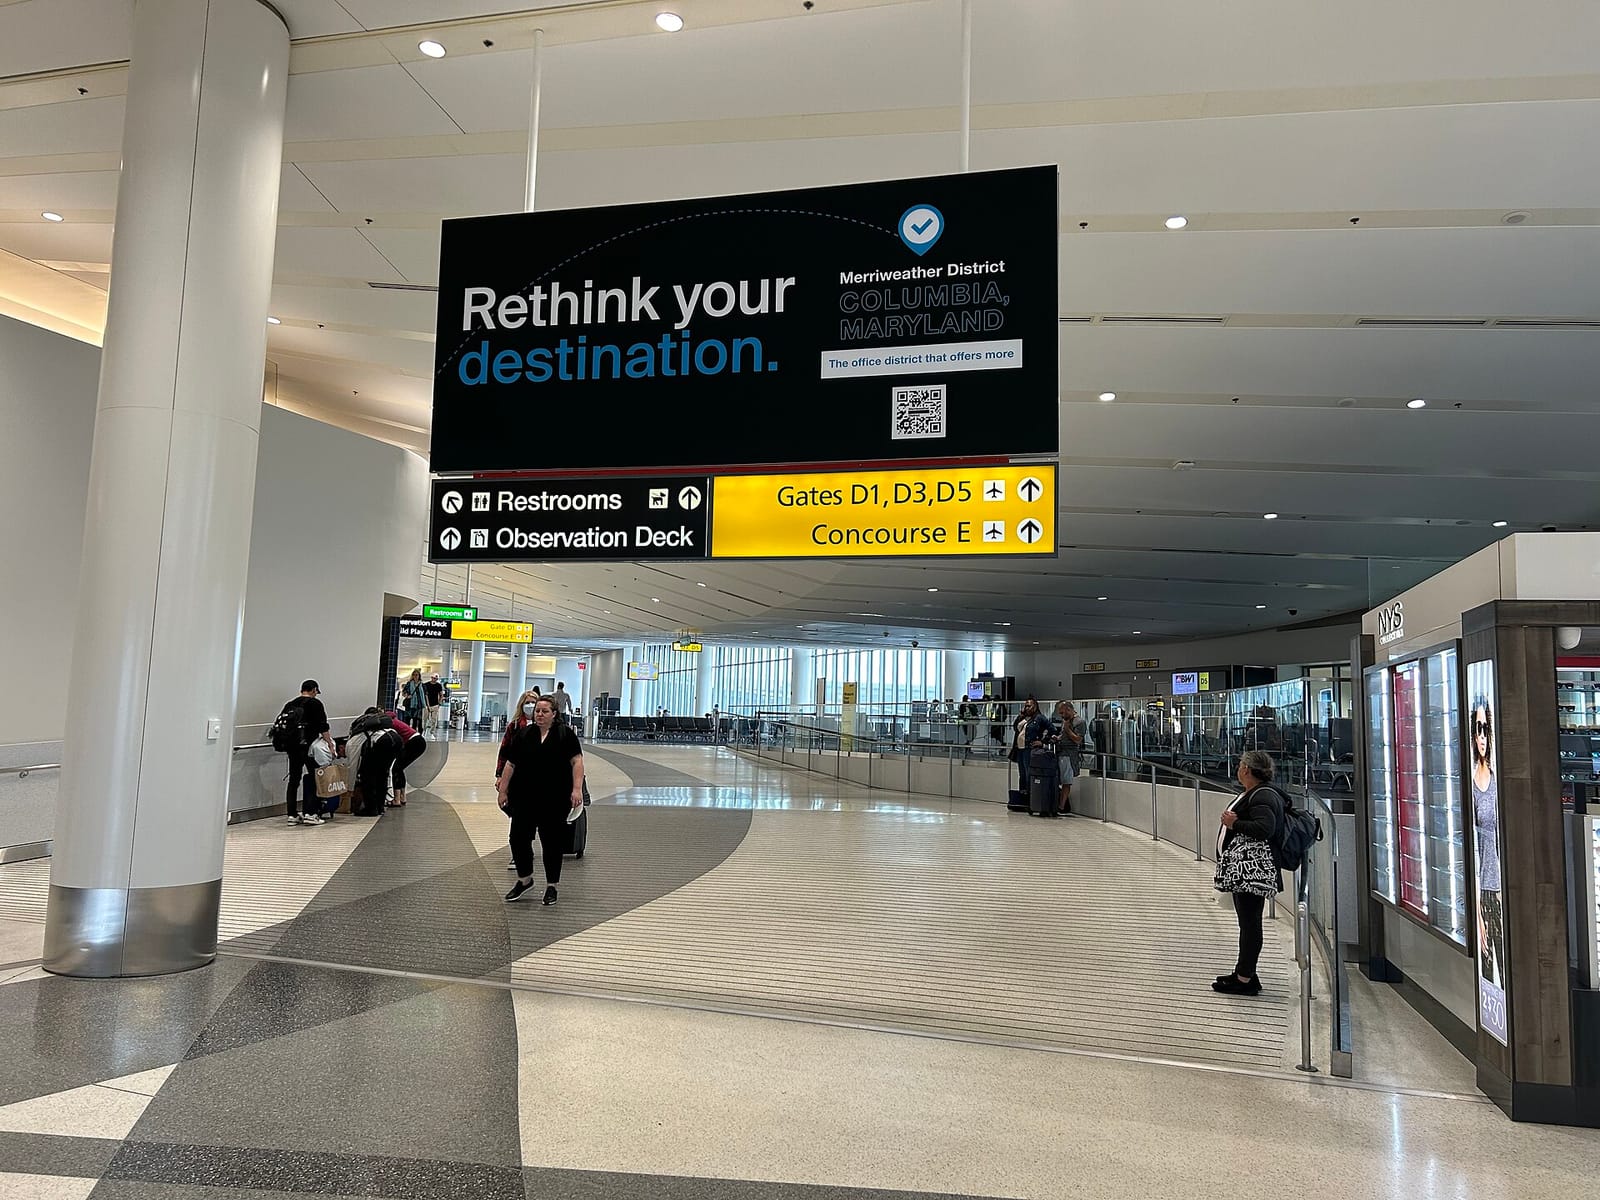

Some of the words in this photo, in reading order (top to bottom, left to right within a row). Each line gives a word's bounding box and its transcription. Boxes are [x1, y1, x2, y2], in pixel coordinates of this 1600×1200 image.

[840, 264, 943, 285] Merriweather
[947, 260, 1006, 277] District
[462, 276, 661, 331] Rethink
[672, 276, 796, 330] your
[839, 281, 1010, 314] COLUMBIA,
[840, 309, 1004, 341] MARYLAND
[458, 329, 779, 386] destination.
[829, 359, 849, 369] The
[851, 356, 882, 368] office
[884, 354, 923, 366] district
[925, 353, 947, 363] that
[949, 350, 982, 362] offers
[985, 350, 1015, 359] more
[497, 490, 623, 512] Restrooms
[777, 485, 843, 507] Gates
[496, 525, 628, 549] Observation
[635, 525, 694, 548] Deck
[811, 523, 947, 545] Concourse
[957, 521, 971, 543] E
[429, 609, 463, 617] Restrooms
[431, 620, 448, 628] Deck
[1378, 600, 1404, 637] NYS
[410, 627, 425, 637] Play
[425, 629, 442, 637] Area
[1200, 677, 1208, 685] D5
